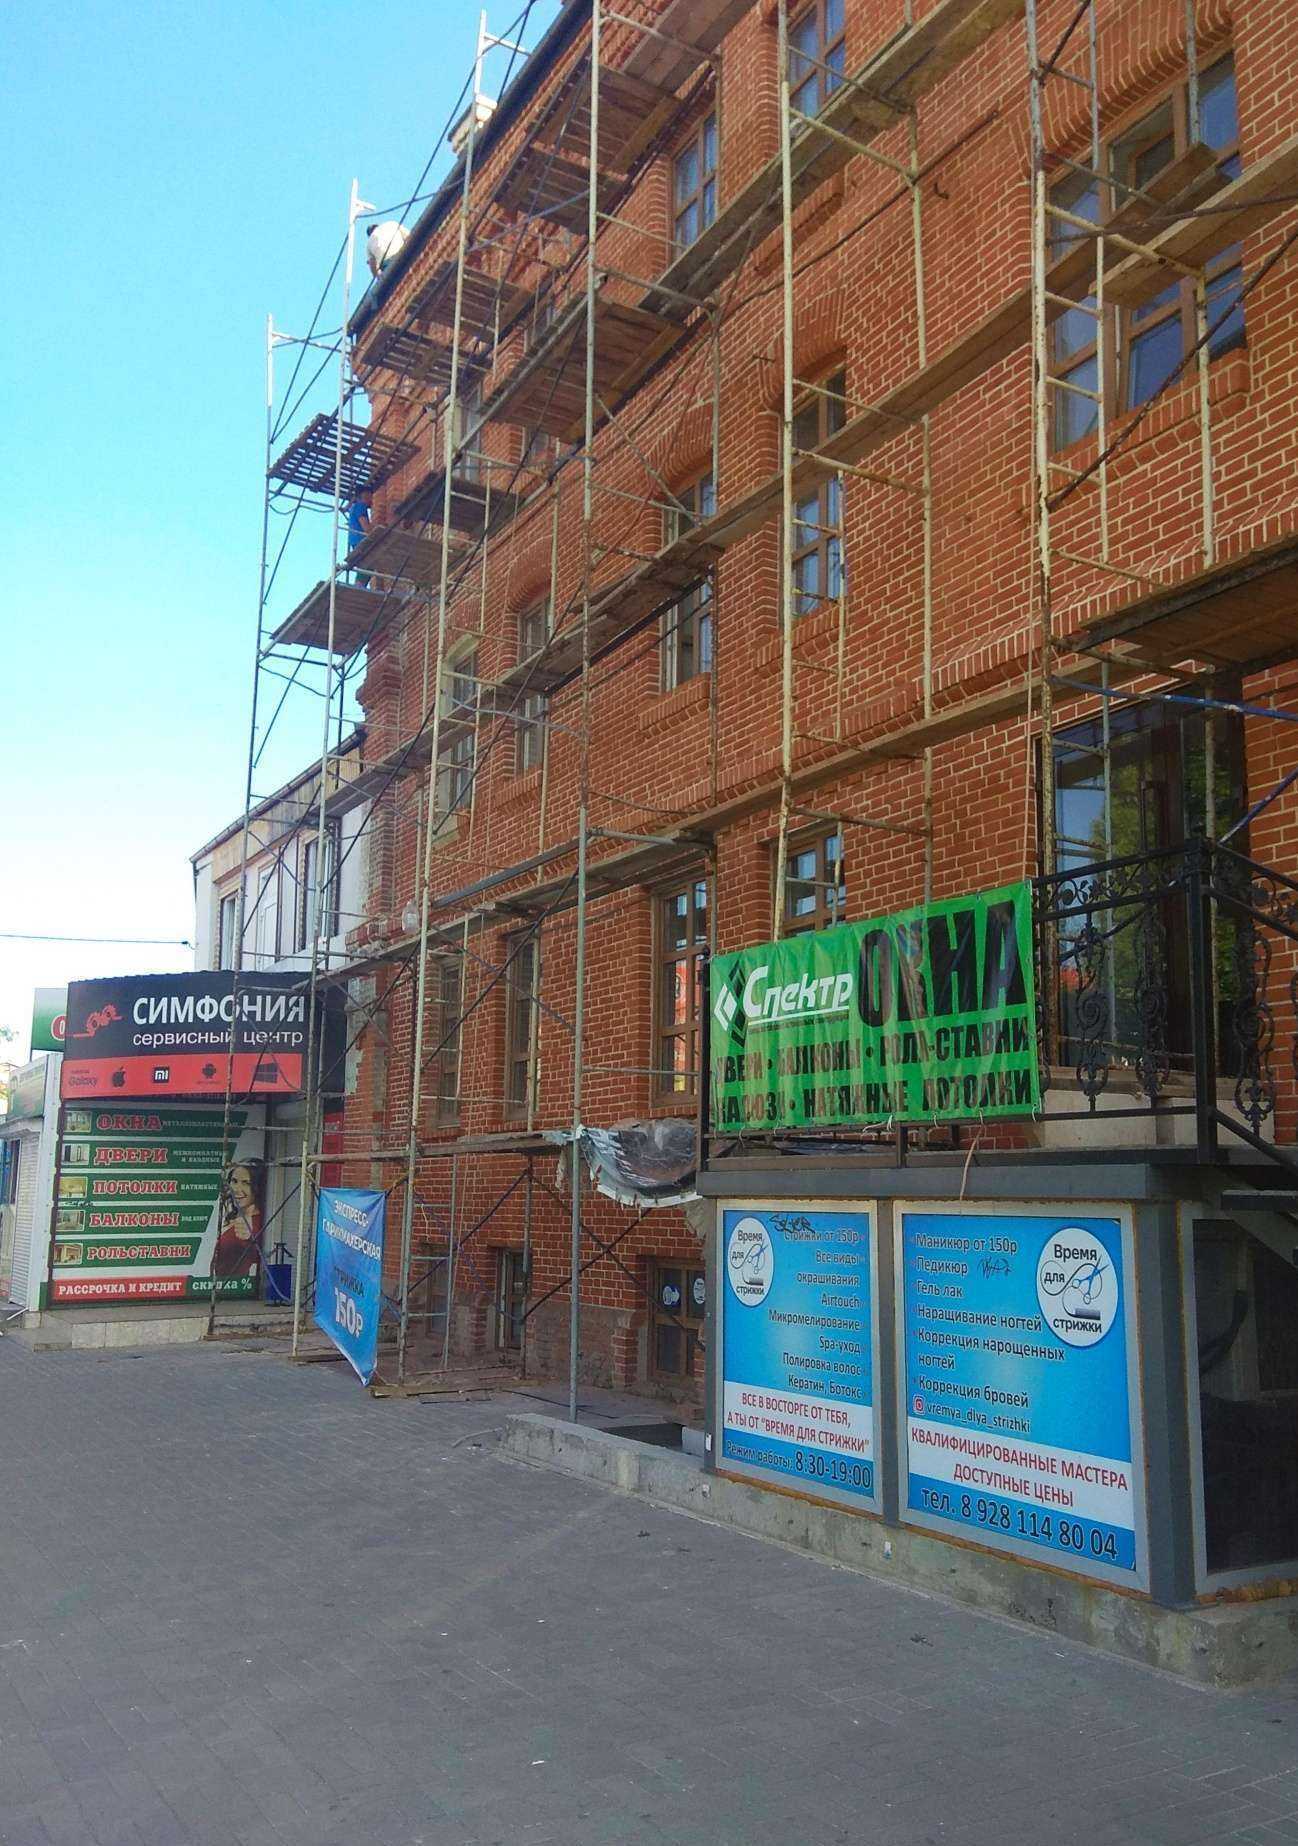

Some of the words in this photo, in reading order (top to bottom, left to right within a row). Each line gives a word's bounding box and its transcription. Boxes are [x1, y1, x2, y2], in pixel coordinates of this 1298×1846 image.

[857, 901, 1027, 1027] ОКНА
[744, 965, 852, 1018] Спектр
[133, 995, 304, 1024] СИМФОНИЯ
[133, 1029, 234, 1047] сервисный
[244, 1031, 303, 1046] центр
[97, 1114, 162, 1130] ОКНА
[94, 1147, 168, 1165] ДВЕРИ
[93, 1180, 177, 1194] ПОТОЛКИ
[89, 1212, 180, 1227] БАЛКОНЫ
[738, 1230, 763, 1244] Время
[825, 1232, 834, 1240] от
[916, 1233, 970, 1252] Маникюр
[973, 1240, 985, 1250] от
[990, 1237, 1017, 1255] 150р
[87, 1245, 192, 1260] РОЛЬСТАВНИ
[732, 1251, 744, 1260] для
[815, 1249, 831, 1263] Все
[834, 1253, 859, 1265] виды
[1054, 1244, 1097, 1262] Время
[917, 1257, 968, 1276] Педикюр
[797, 1273, 859, 1286] окрашивания
[1044, 1272, 1065, 1284] для
[59, 1284, 125, 1295] РАССРОЧКА
[129, 1283, 137, 1293] И
[139, 1282, 182, 1293] КРЕДИТ
[736, 1285, 764, 1297] стрижки
[917, 1280, 940, 1295] Гель
[944, 1287, 962, 1297] лак
[821, 1293, 859, 1308] Airtouch
[769, 1309, 860, 1330] Микромелирование
[918, 1304, 996, 1326] Наращивание
[1000, 1316, 1042, 1331] ногтей
[1053, 1319, 1102, 1333] стрижки
[819, 1336, 860, 1354] Spa-уход
[918, 1328, 979, 1349] Коррекция
[983, 1338, 1065, 1360] нарощенных
[783, 1353, 831, 1371] Полировка
[833, 1362, 861, 1376] волос
[918, 1354, 955, 1369] ногтей
[788, 1374, 827, 1394] Кератин,
[829, 1381, 862, 1398] Ботокс
[919, 1376, 980, 1398] Коррекция
[984, 1386, 1028, 1408] бровей
[742, 1393, 759, 1406] ВСЕ
[759, 1396, 764, 1408] В
[766, 1397, 808, 1417] ВОСТОРГЕ
[811, 1406, 823, 1419] ОТ
[825, 1408, 851, 1428] ТЕБЯ,
[927, 1403, 1030, 1432] vremya_dlya_strizhki
[727, 1412, 733, 1424] А
[735, 1413, 746, 1426] ТЫ
[749, 1416, 759, 1428] ОТ
[797, 1427, 816, 1441] ДЛЯ
[727, 1441, 756, 1459] Режим
[758, 1449, 792, 1469] работы:
[795, 1451, 871, 1488] 8:30-19:00
[911, 1427, 1057, 1474] КВАЛИФИЦИРОВАННЫЕ
[1061, 1460, 1128, 1491] МАСТЕРА
[953, 1464, 1030, 1496] ДОСТУПНЫЕ
[1034, 1483, 1073, 1506] ЦЕНЫ
[921, 1489, 956, 1514] тел.
[961, 1494, 971, 1518] 8
[977, 1498, 1011, 1529] 928
[1017, 1509, 1052, 1541] 114
[1059, 1520, 1084, 1550] 80
[1090, 1529, 1117, 1559] 04
